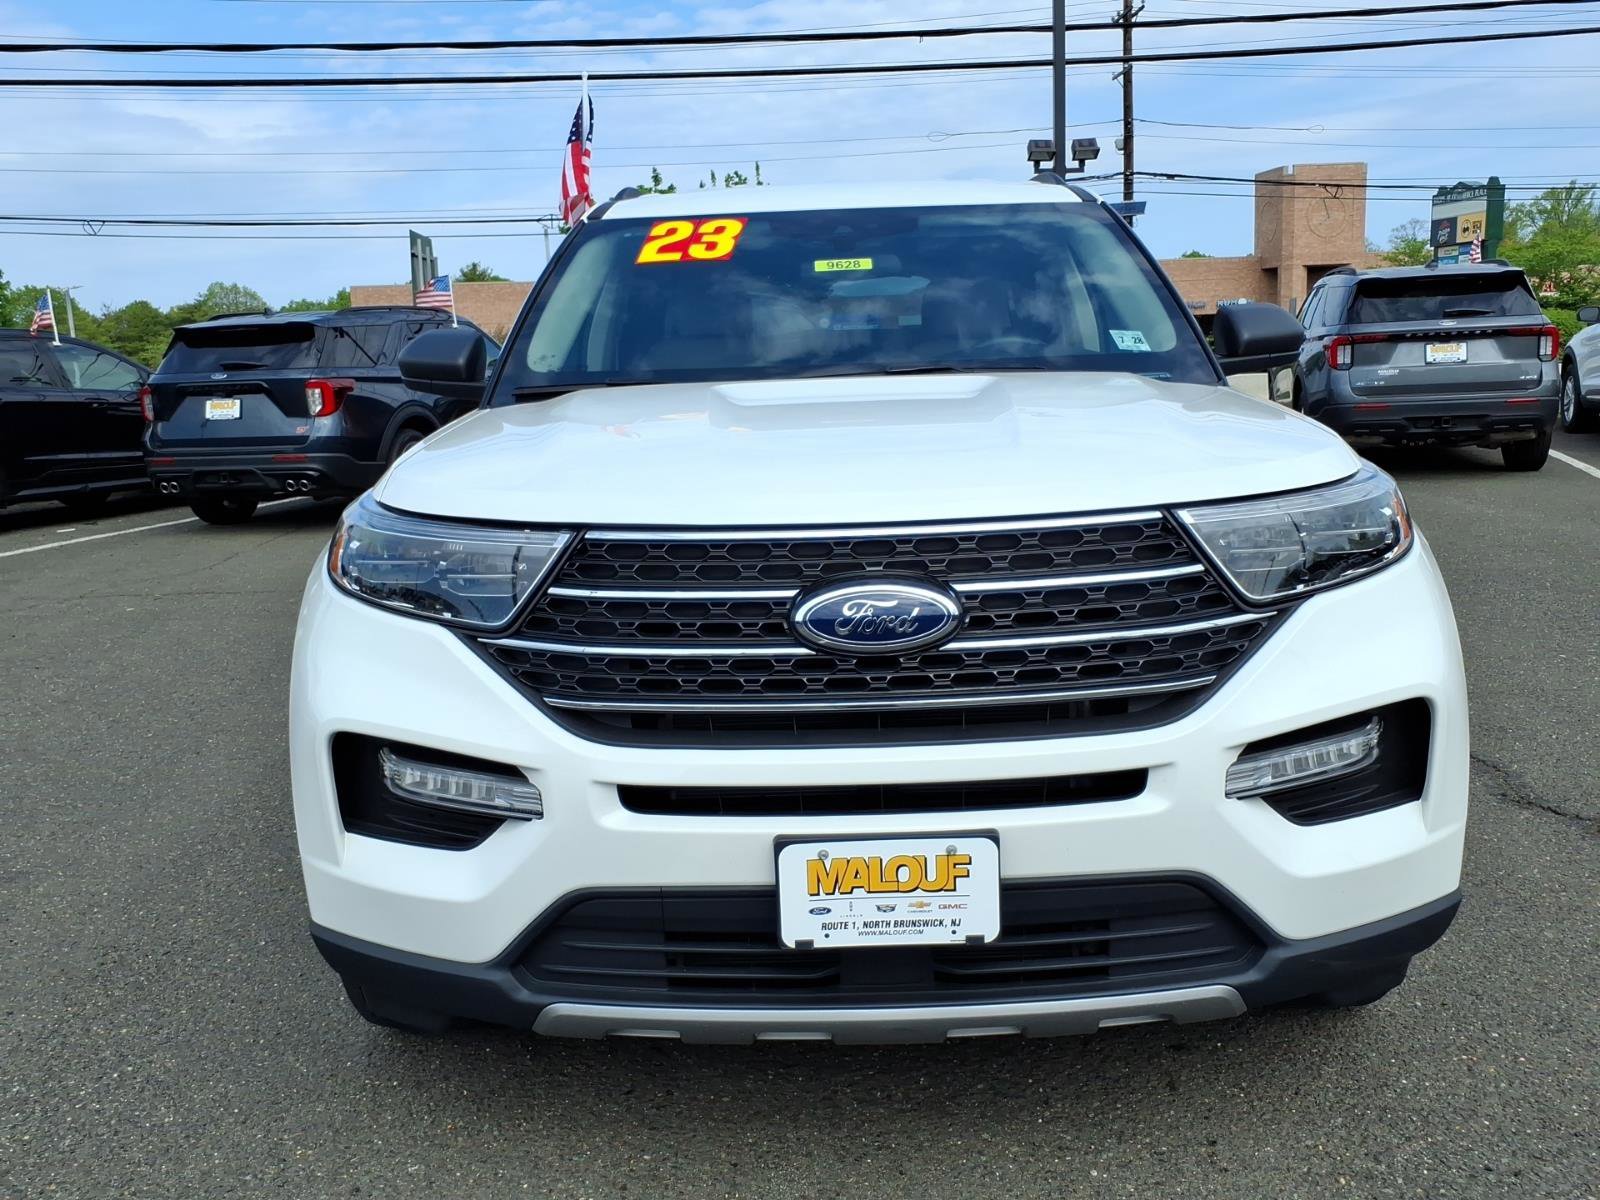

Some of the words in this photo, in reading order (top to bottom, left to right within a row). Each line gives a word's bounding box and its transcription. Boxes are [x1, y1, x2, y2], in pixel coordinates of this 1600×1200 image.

[635, 218, 744, 264] 23
[826, 260, 862, 270] 9628
[1131, 336, 1144, 345] 28
[834, 599, 920, 636] Ford
[806, 853, 972, 897] MALOUF
[821, 921, 849, 931] ROUTE
[852, 921, 860, 931] 1,
[862, 920, 891, 930] NORTH
[893, 918, 948, 929] BRUNSWICK,
[950, 918, 962, 928] NJ
[858, 928, 924, 937] WWW.MALOUF.COM
